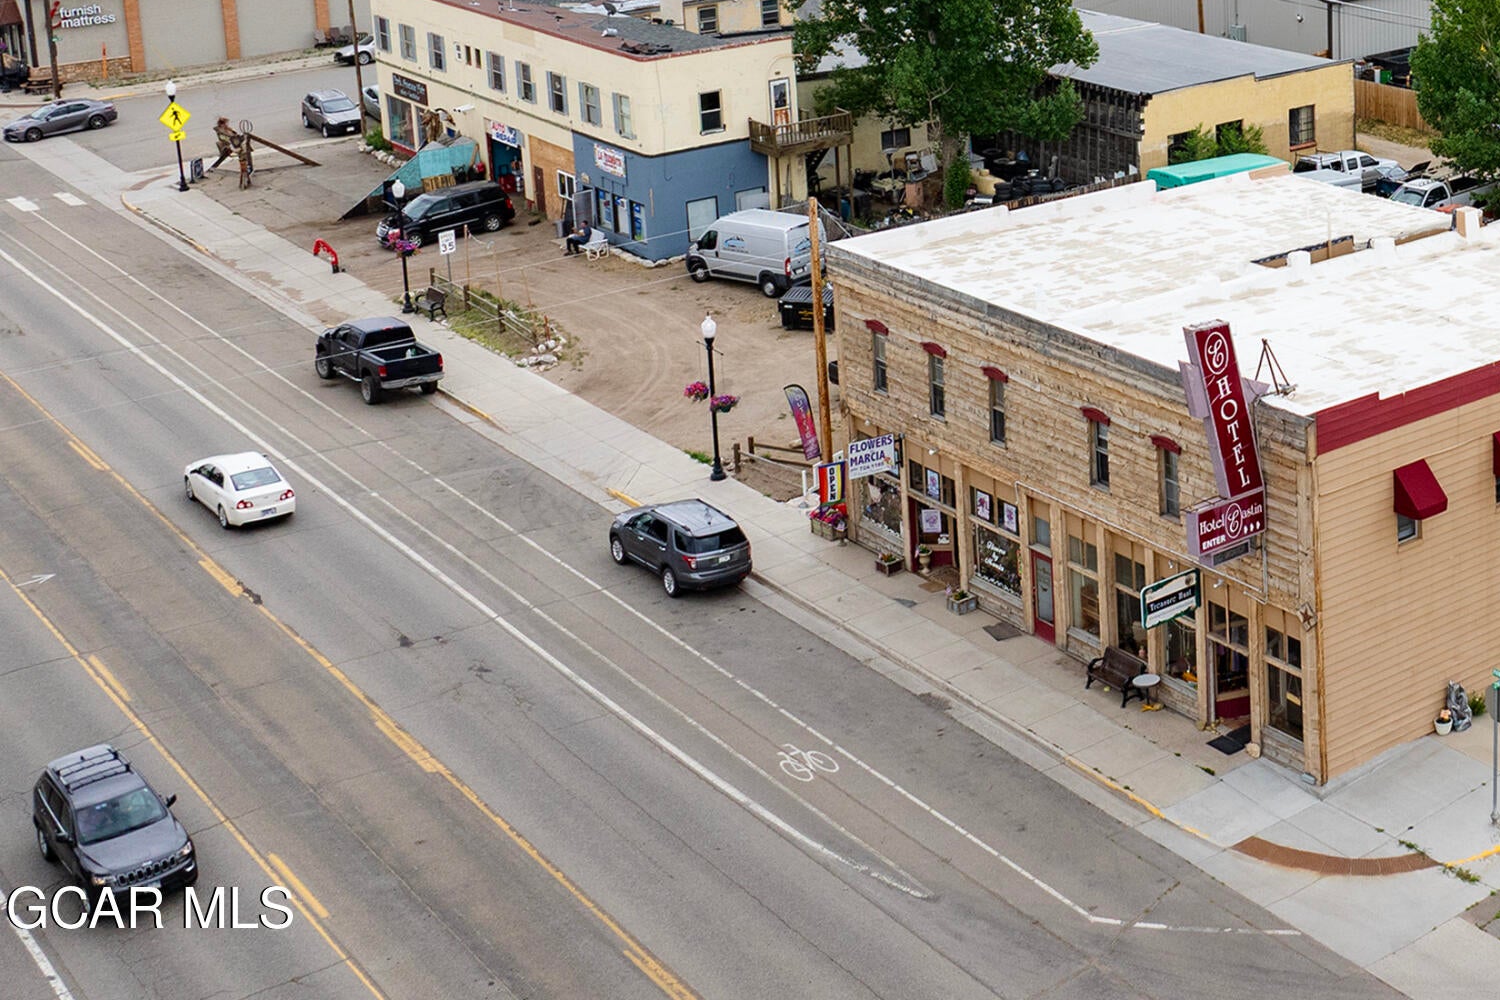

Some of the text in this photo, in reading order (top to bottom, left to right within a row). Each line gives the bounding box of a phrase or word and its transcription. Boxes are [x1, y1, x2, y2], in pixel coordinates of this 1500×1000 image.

[60, 4, 102, 18] furnish
[61, 14, 116, 29] mattress
[491, 121, 505, 134] AUTO
[495, 131, 517, 145] REPAIR
[441, 241, 455, 253] 35
[1216, 374, 1250, 488] HOTEL
[850, 434, 893, 454] FLOWERS
[850, 450, 886, 467] MARCIA
[828, 467, 836, 501] OPEN
[1200, 513, 1225, 536] Hotel
[1202, 534, 1226, 550] ENTER
